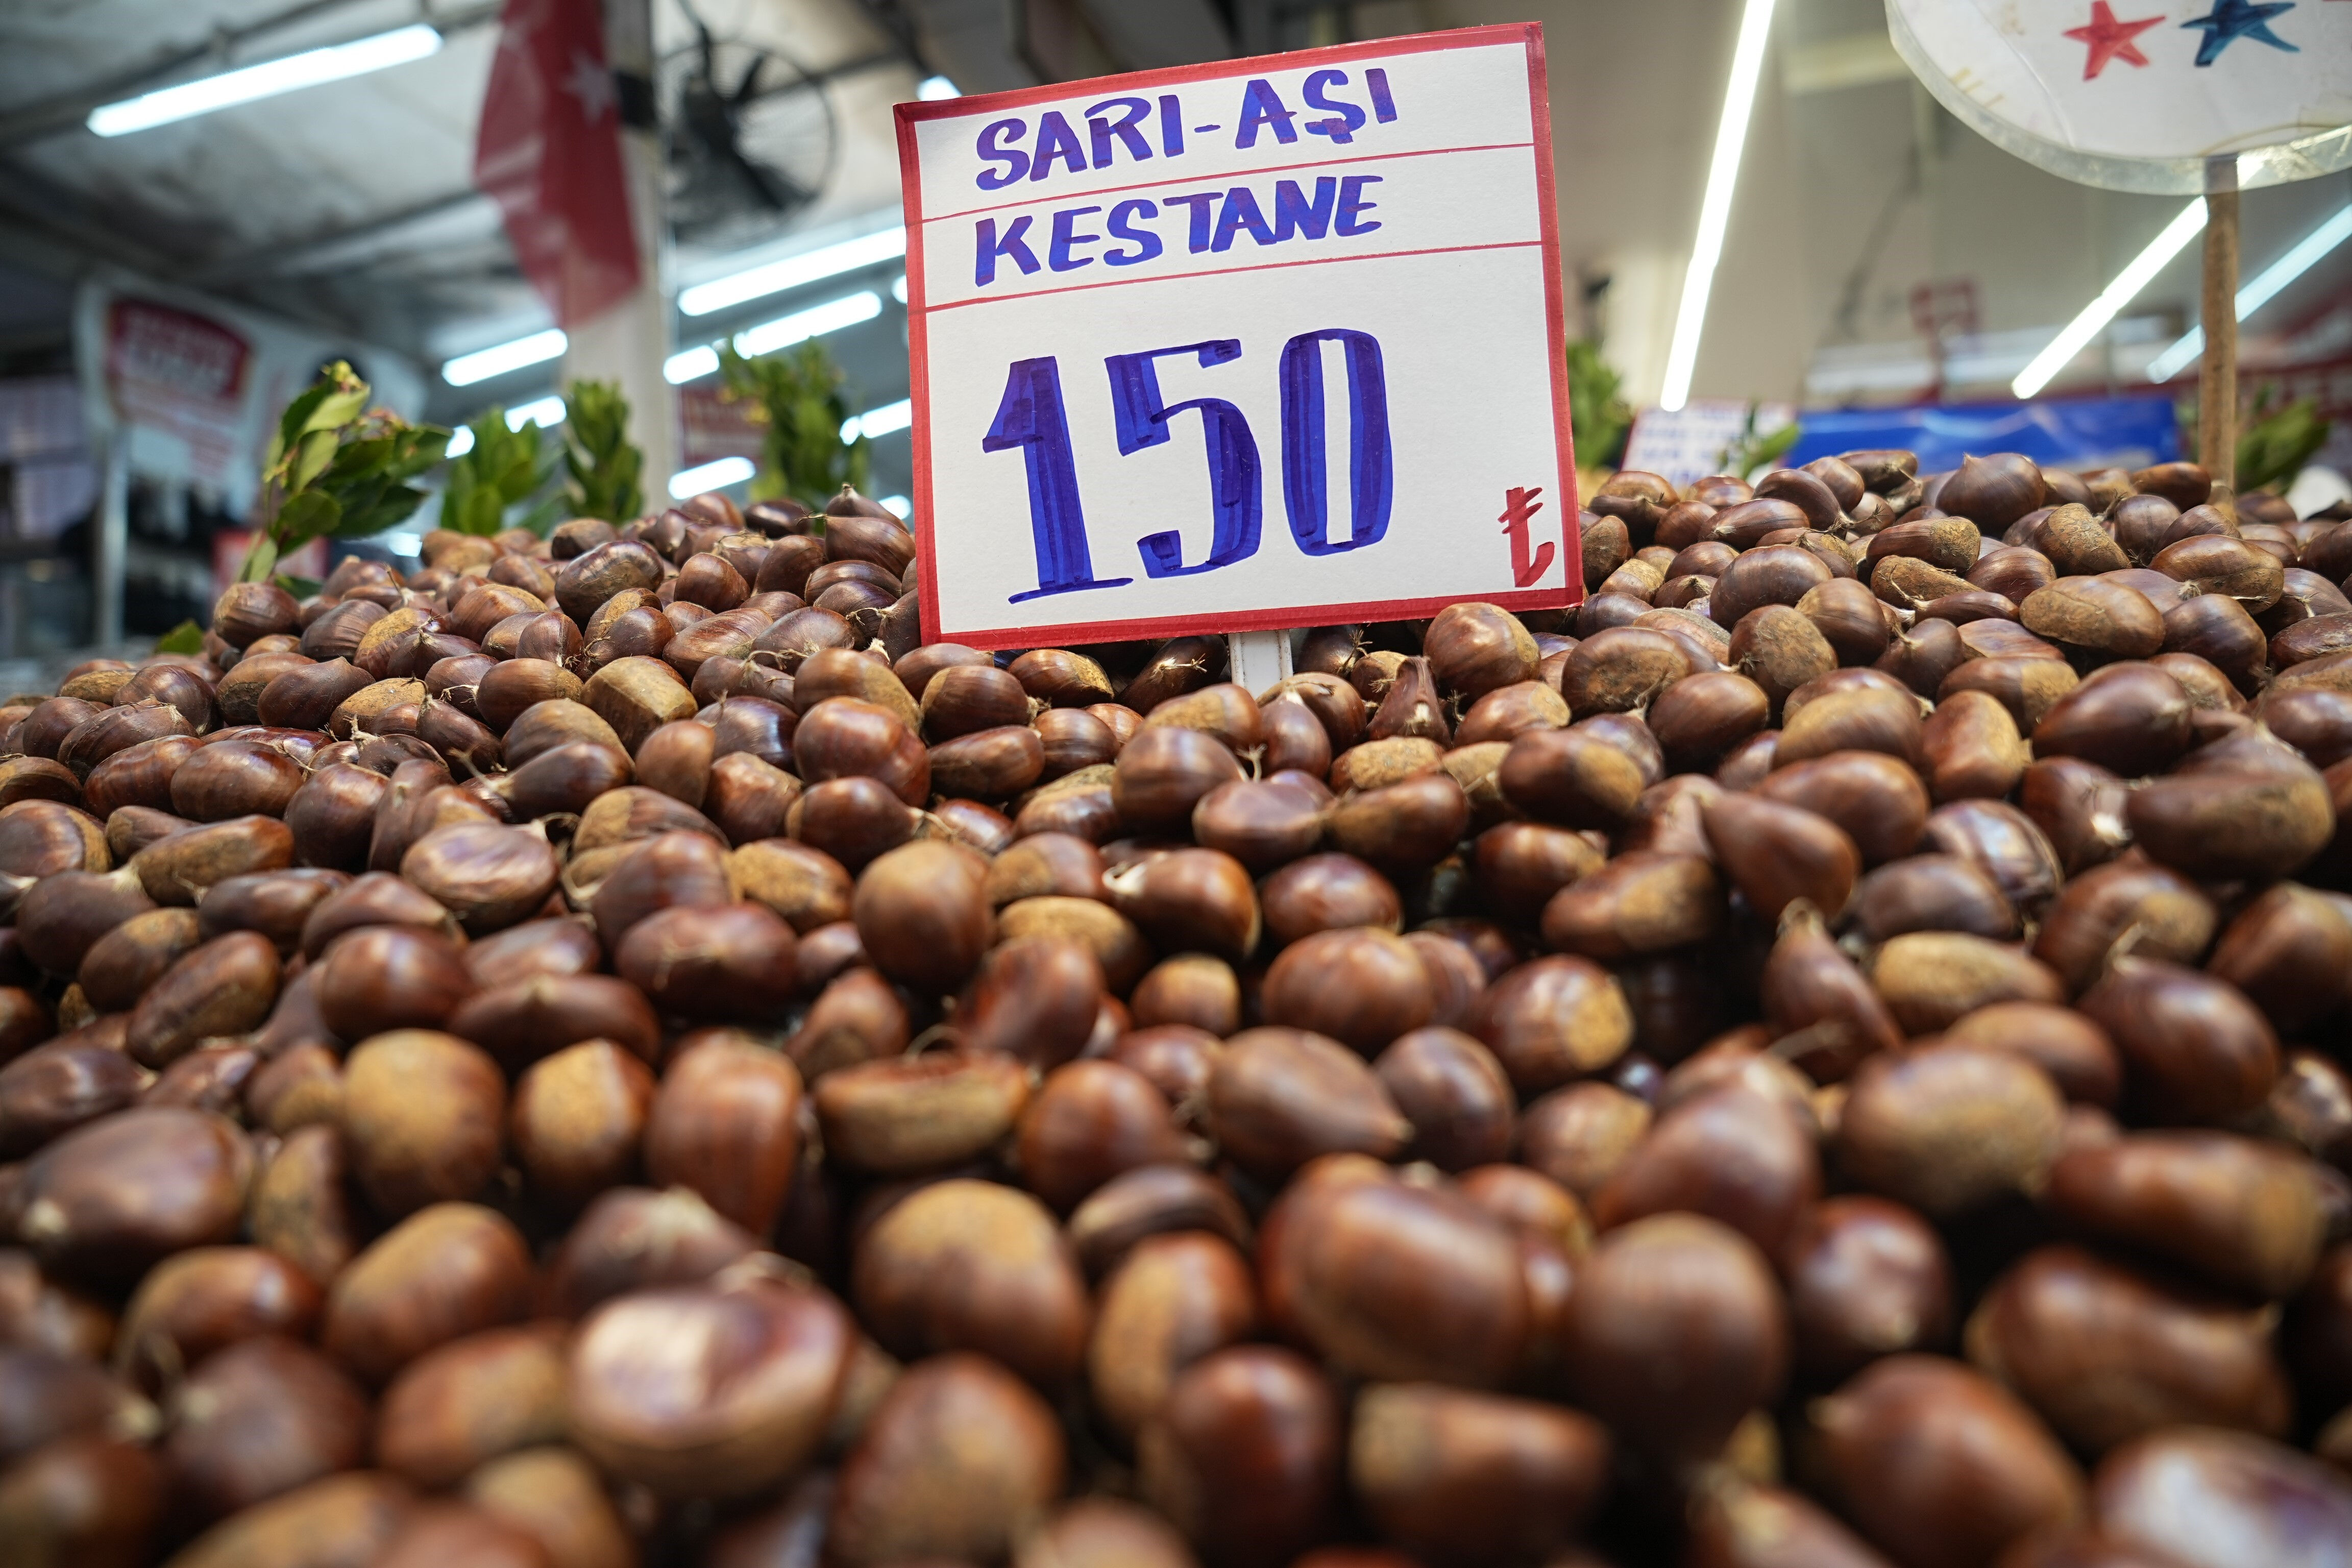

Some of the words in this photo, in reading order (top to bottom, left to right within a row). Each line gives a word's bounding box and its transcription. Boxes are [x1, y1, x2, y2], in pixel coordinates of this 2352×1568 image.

[975, 67, 1398, 191] SARI-AŞI
[974, 175, 1384, 287] KESTANE
[982, 328, 1393, 605] 150
